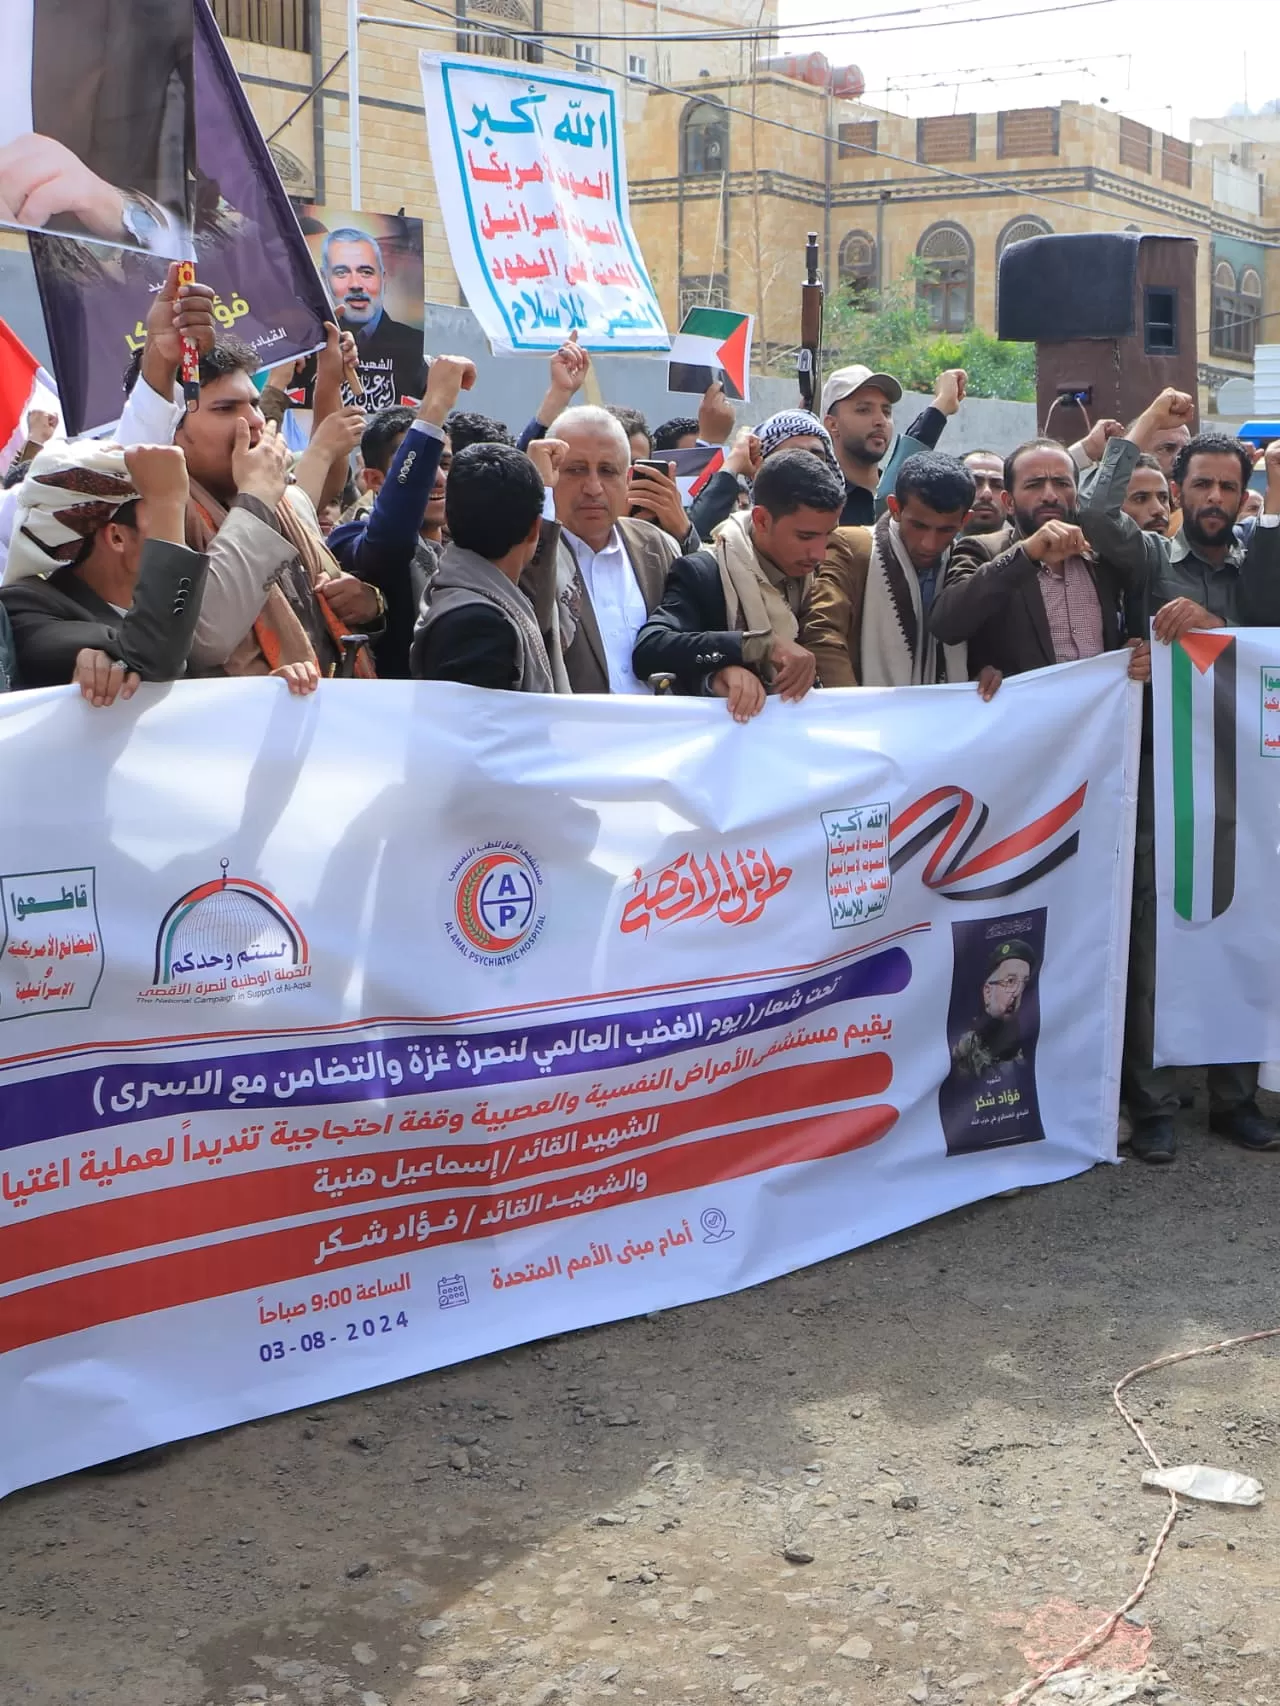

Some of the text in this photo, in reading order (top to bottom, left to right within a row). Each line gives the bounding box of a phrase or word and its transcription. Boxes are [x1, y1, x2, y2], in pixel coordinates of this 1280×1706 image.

[461, 84, 608, 149] الله أكبر
[491, 247, 559, 285] اليهود
[829, 809, 888, 839] الله أكبر
[862, 834, 887, 852] الموت
[862, 855, 887, 872] الموت
[10, 884, 88, 921] قاطعوا
[498, 874, 516, 896] A
[500, 905, 516, 927] P
[58, 932, 98, 960] البضائع
[444, 914, 546, 967] AL AMAL PSYCHIATRIC HOSPITAL
[171, 942, 287, 980] لستم وحدكم
[274, 965, 312, 981] الحملة
[194, 994, 236, 1006] Campaign
[247, 987, 275, 999] Support
[276, 985, 283, 994] of
[195, 977, 227, 997] لنصرة
[231, 971, 271, 990] الوطنية
[804, 975, 843, 1004] تحت
[750, 988, 802, 1026] شعار
[532, 1024, 620, 1075] العالمي
[625, 1012, 704, 1053] الغضب
[752, 1023, 839, 1068] مستشفى
[842, 1015, 893, 1050] يقيم
[407, 1042, 451, 1082] غزة
[456, 1037, 528, 1074] لنصرة
[674, 1042, 753, 1091] الأمراض
[228, 1074, 267, 1104] مع
[272, 1051, 403, 1099] والتضامن
[584, 1068, 674, 1108] النفسية
[471, 1091, 580, 1129] والعصبية
[975, 1088, 1021, 1112] فؤاد شكر
[270, 1113, 393, 1153] احتجاجية
[398, 1108, 464, 1135] وقفة
[581, 1112, 660, 1151] الشهيد
[79, 1137, 175, 1187] لعملية
[518, 1130, 578, 1166] القائد
[1, 1157, 71, 1207] اغتيا
[312, 1164, 377, 1199] هنية
[382, 1150, 500, 1189] إسماعيل
[545, 1167, 648, 1210] والشهيد
[393, 1202, 458, 1241] فؤاد
[479, 1192, 543, 1227] القائد
[312, 1218, 388, 1264] شكر
[490, 1220, 694, 1289] أمام مبنى الأمم المتحدة
[310, 1287, 353, 1313] 9:00
[356, 1273, 412, 1302] الساعة
